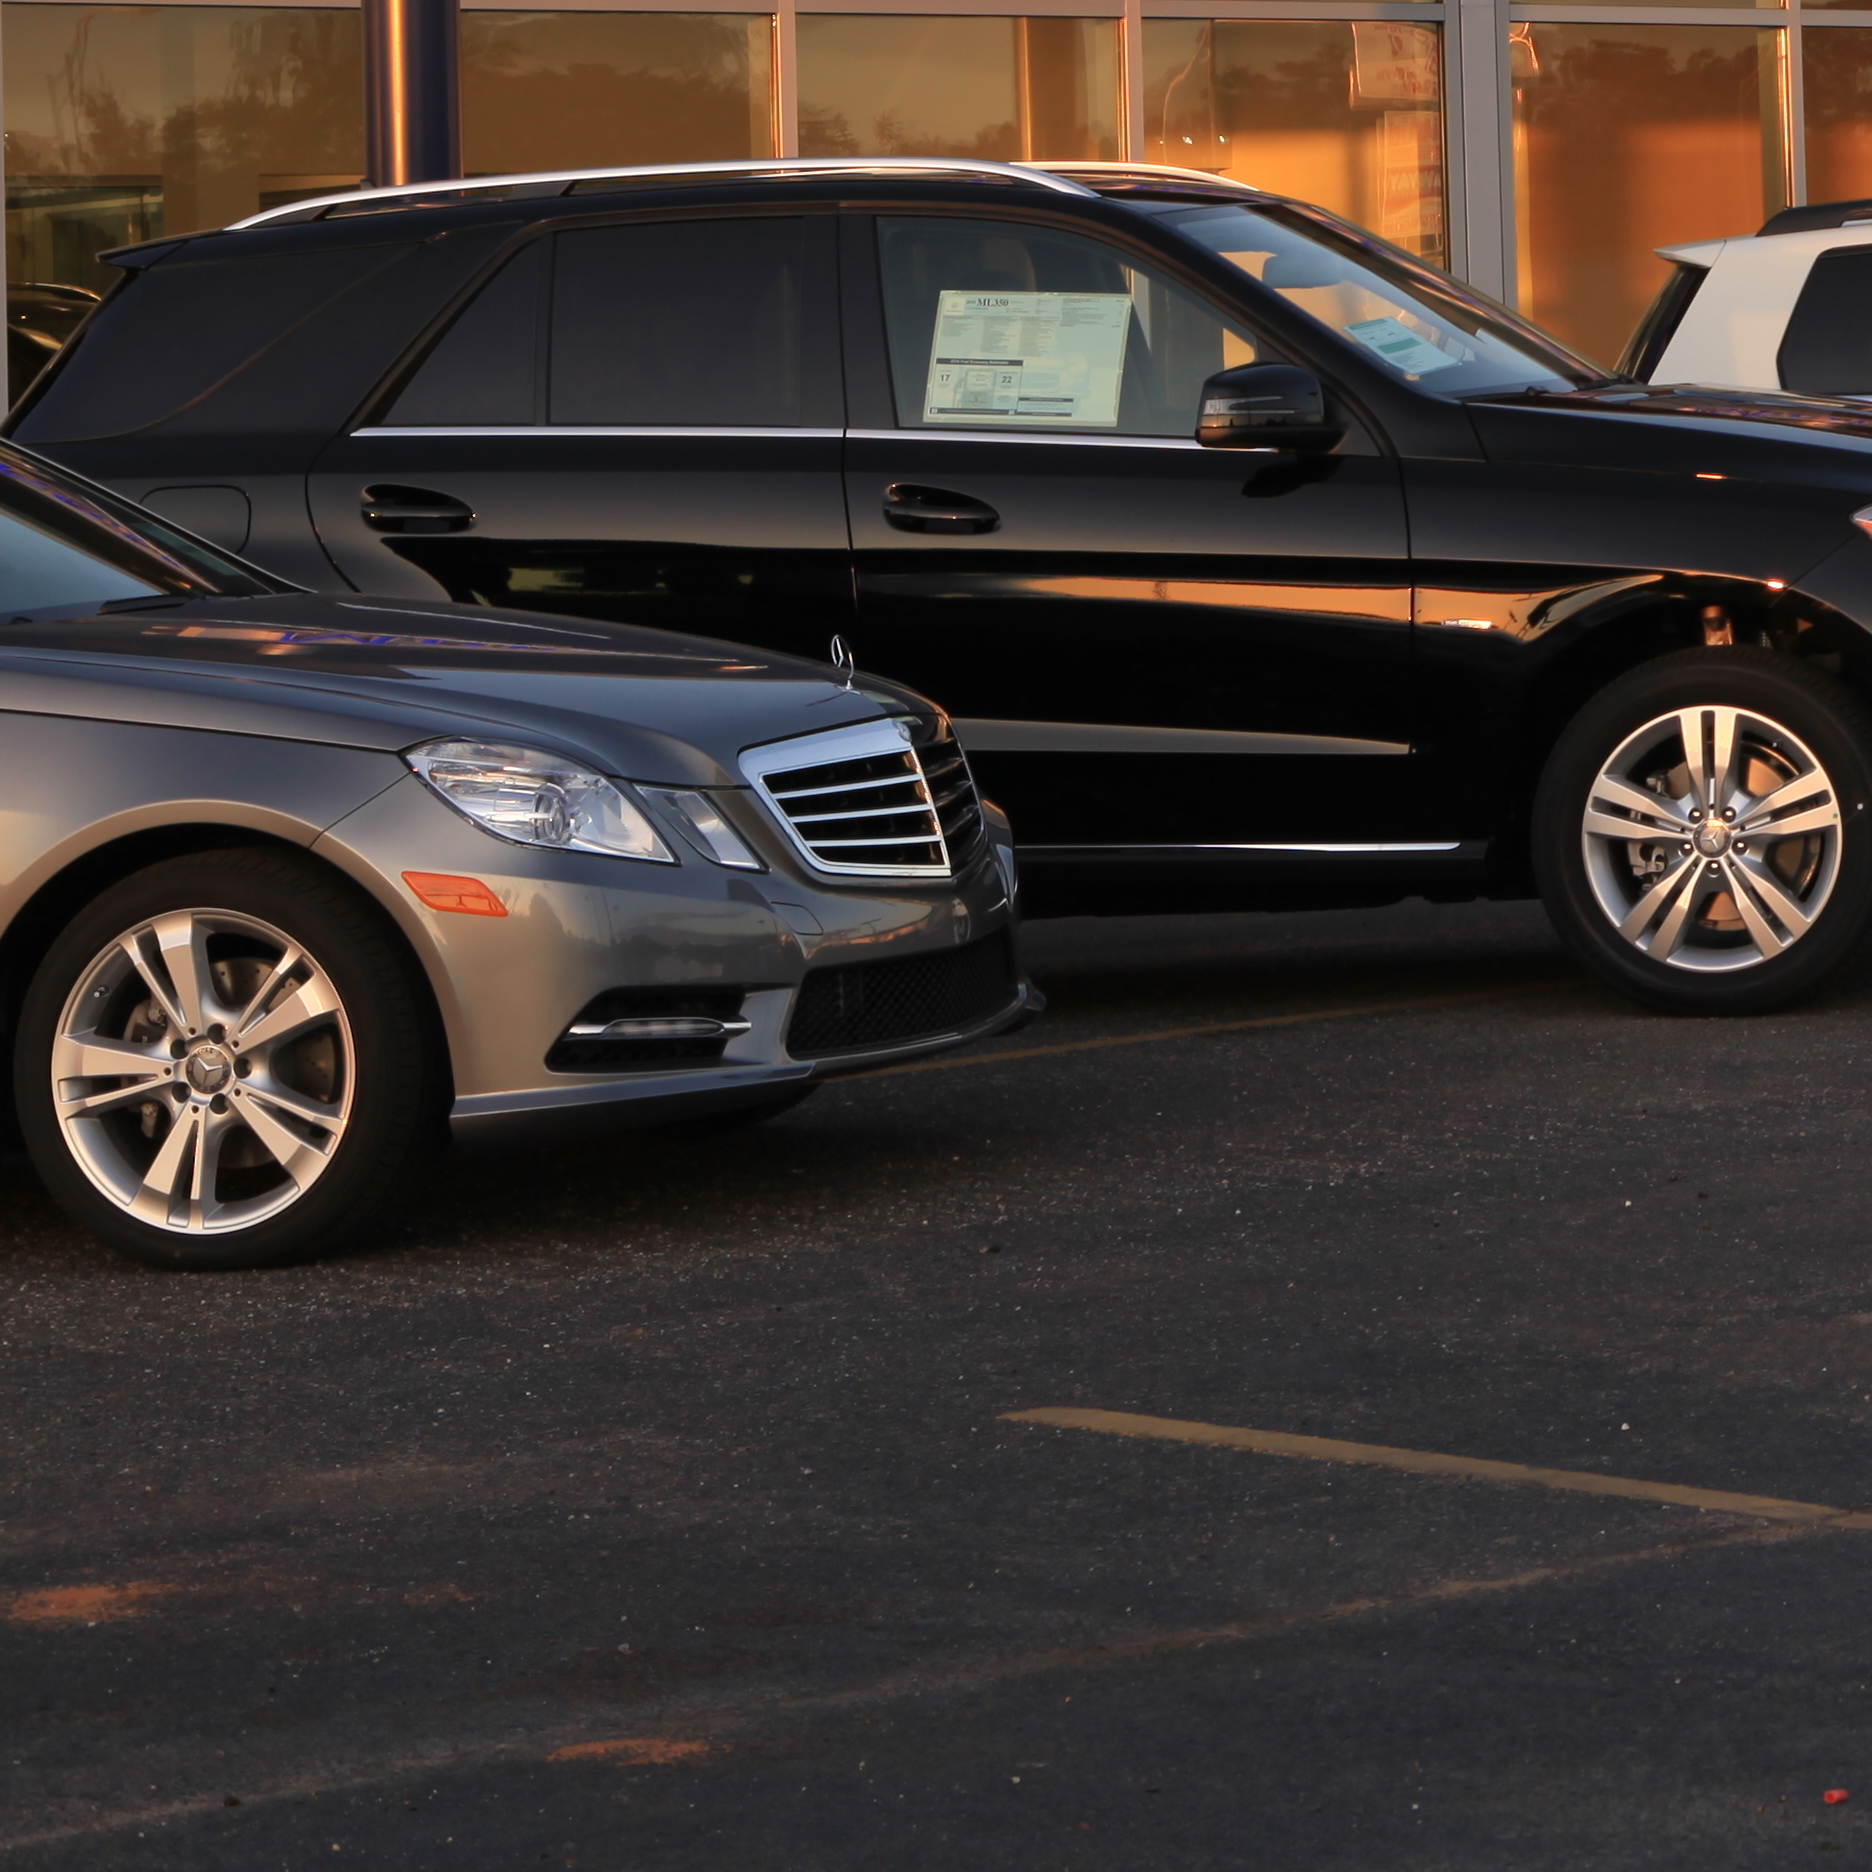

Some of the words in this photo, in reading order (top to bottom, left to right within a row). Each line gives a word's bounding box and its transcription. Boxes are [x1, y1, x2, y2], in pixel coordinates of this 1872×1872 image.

[977, 298, 1009, 307] ML350
[940, 374, 951, 382] 17
[1001, 376, 1012, 384] 22
